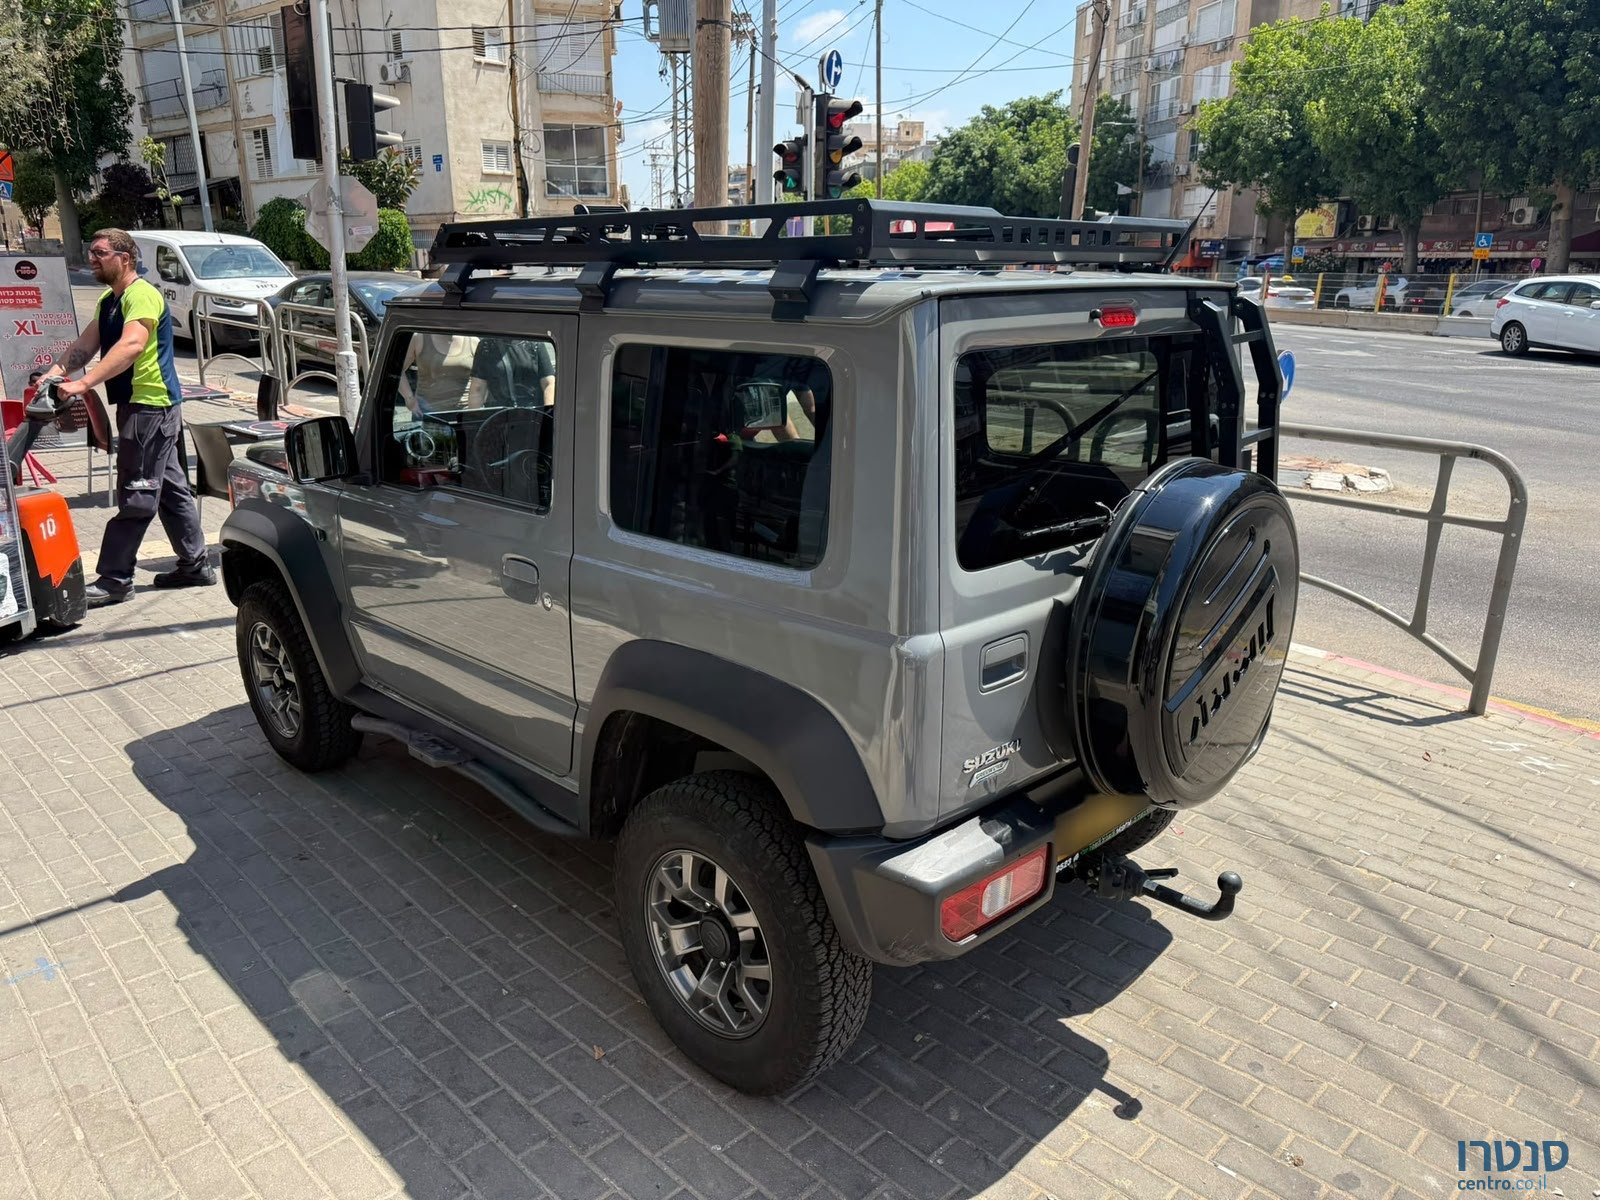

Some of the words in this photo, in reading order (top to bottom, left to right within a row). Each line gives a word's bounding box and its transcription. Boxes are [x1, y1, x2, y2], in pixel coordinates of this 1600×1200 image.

[164, 288, 177, 301] HFD
[13, 319, 43, 336] XL
[34, 354, 52, 365] 49
[39, 516, 57, 541] 10
[962, 739, 1022, 774] SUZUKI
